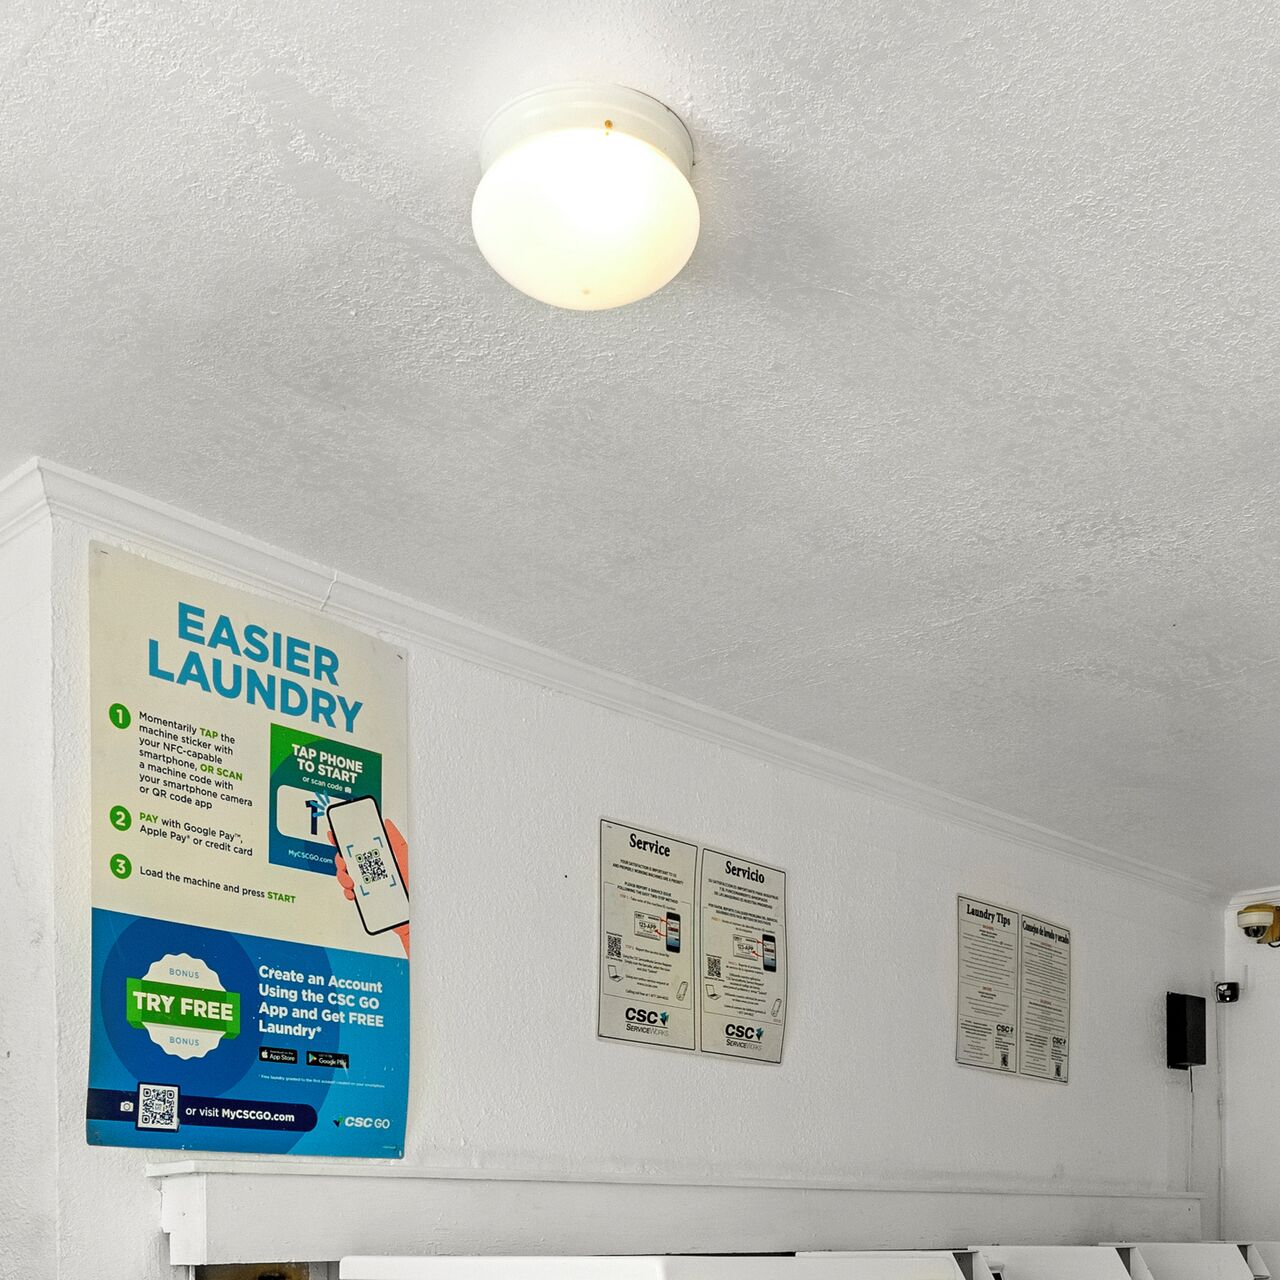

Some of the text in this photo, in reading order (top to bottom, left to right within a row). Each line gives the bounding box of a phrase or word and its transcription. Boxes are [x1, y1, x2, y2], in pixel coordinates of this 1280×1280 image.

[178, 601, 339, 686] EASIER
[149, 638, 363, 734] LAUNDRY
[116, 708, 123, 724] 1
[139, 711, 235, 744] Momentarily TAP the
[139, 725, 233, 755] machine sticker with
[139, 737, 223, 764] your NFC-capable
[139, 749, 243, 781] smartphone, OR SCAN
[292, 744, 363, 773] TAP PHONE
[139, 761, 234, 790] a machine code with
[297, 758, 358, 784] TO START
[139, 773, 253, 806] your smartphone camera
[311, 778, 326, 787] scan
[327, 782, 343, 791] code
[139, 786, 213, 810] or QR code app
[115, 811, 126, 827] 2
[140, 812, 158, 824] PAY
[161, 817, 181, 829] with
[184, 823, 217, 837] Google
[305, 800, 318, 835] 1
[140, 825, 168, 838] Apple
[193, 837, 202, 845] or
[205, 839, 231, 852] credit
[233, 845, 253, 856] card
[629, 833, 670, 857] Service
[116, 859, 126, 874] 3
[288, 849, 333, 864] MyCSCGO.com
[725, 860, 764, 883] Servicio
[140, 866, 296, 903] Load the machine and press START
[966, 904, 1011, 927] Laundry Tips
[169, 968, 200, 979] BONUS
[259, 965, 383, 993] Create an Account
[133, 991, 234, 1021] TRY FREE
[259, 983, 380, 1010] Using the CSC GO
[259, 1002, 384, 1027] App and Get FREE
[625, 1007, 658, 1024] CSC
[725, 1024, 755, 1039] CSC
[996, 1024, 1010, 1033] CSC
[1052, 1036, 1063, 1045] CSC
[169, 1036, 200, 1047] BONUS
[319, 1058, 336, 1066] Google
[186, 1106, 295, 1122] or visit MyCSCGO.com
[345, 1116, 390, 1129] CSC GO
